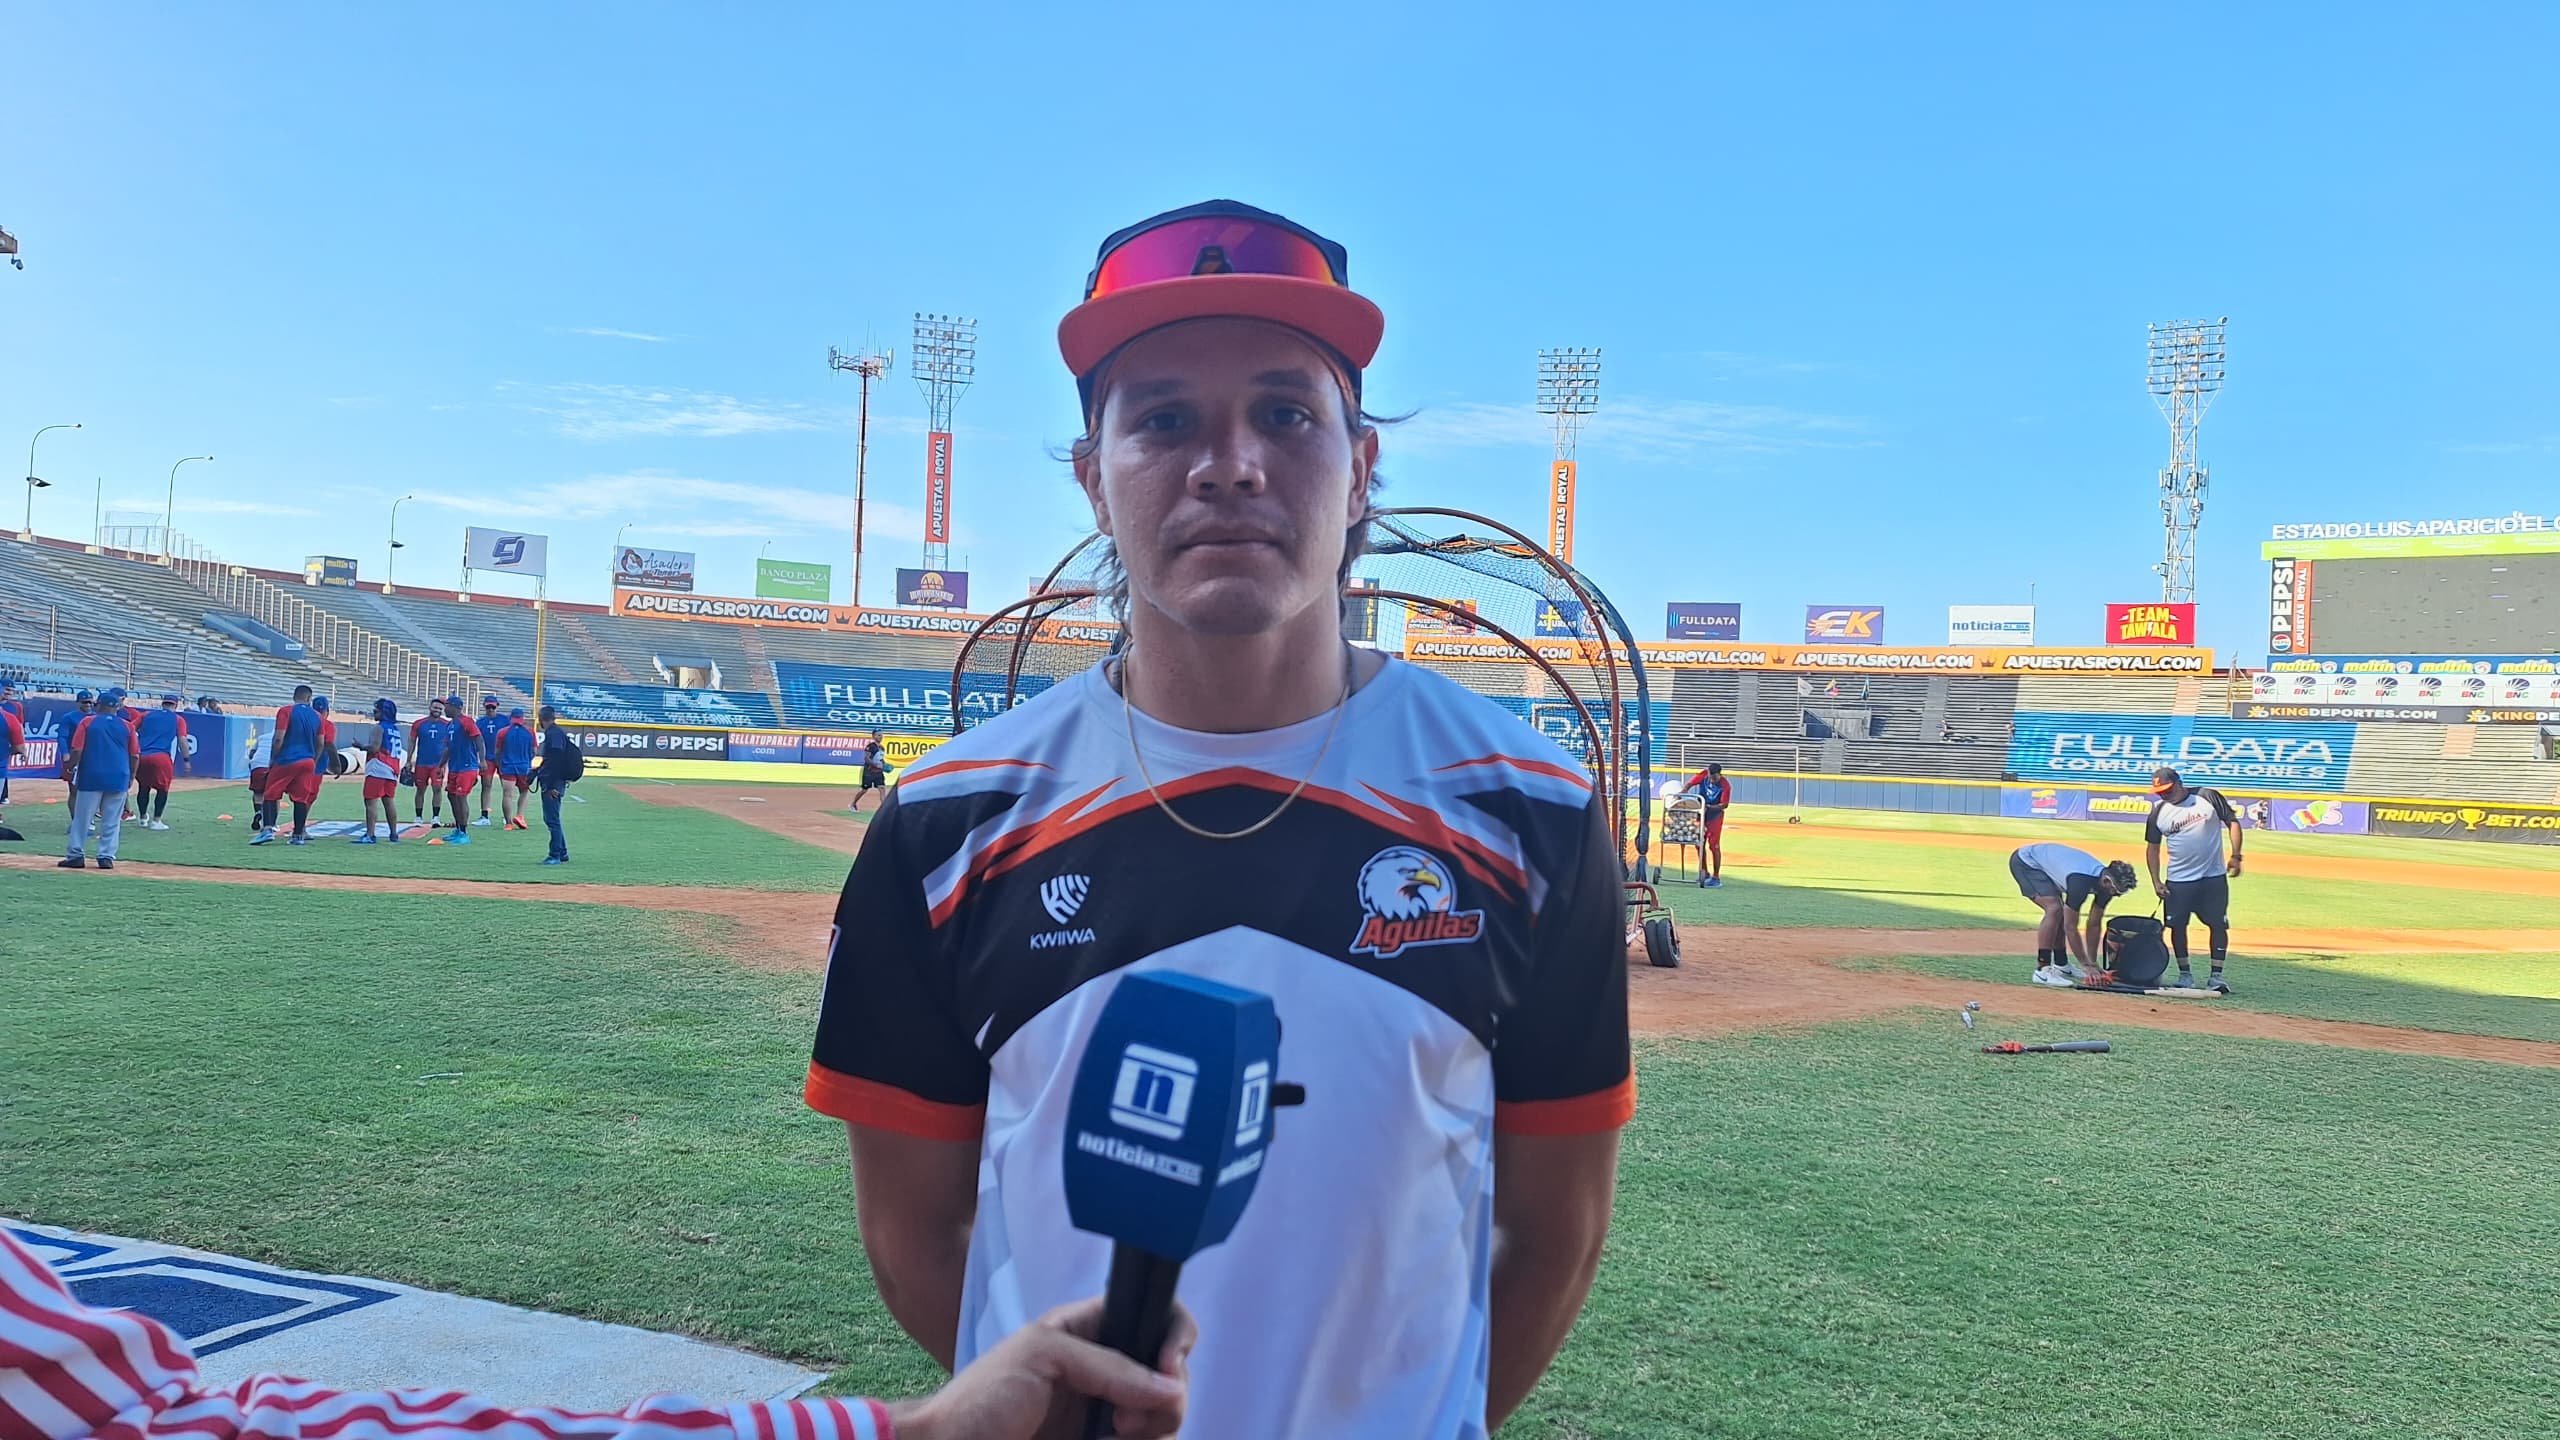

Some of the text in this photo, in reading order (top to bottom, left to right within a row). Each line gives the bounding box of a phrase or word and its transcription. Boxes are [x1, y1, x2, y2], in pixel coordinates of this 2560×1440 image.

[932, 437, 945, 538] APUESTAS ROYAL
[1557, 465, 1568, 504] ROYAL
[2272, 523, 2361, 539] ESTADIO
[2365, 521, 2411, 537] LUIS
[2414, 517, 2517, 535] APARICIO
[760, 567, 794, 579] BANCO
[797, 571, 828, 582] PLAZA
[2271, 558, 2294, 632] PEPSI
[627, 593, 830, 624] APUESTASROYAL.COM
[2128, 606, 2170, 623] TEAM
[2295, 567, 2307, 648] APUESTAS ROYAL
[1680, 616, 1737, 626] FULLDATA
[1952, 620, 2002, 631] noticia
[2120, 621, 2177, 640] TAWALA
[1794, 652, 1974, 668] APUESTASROYAL.COM
[2004, 655, 2202, 671] APUESTASROYAL.COM
[2270, 707, 2438, 719] KINGDEPORTES.COM
[597, 733, 648, 749] PEPSI
[670, 736, 724, 751] PEPSI
[729, 733, 799, 748] SELLATUPARLEY
[2052, 733, 2333, 763] FULLDATA
[752, 746, 775, 755] .com
[828, 749, 852, 757] .com
[2375, 808, 2457, 825] TRIUNFO
[1029, 927, 1096, 950] KWIIWA
[1359, 912, 1480, 953] Aguilas
[1077, 1130, 1155, 1172] noticia
